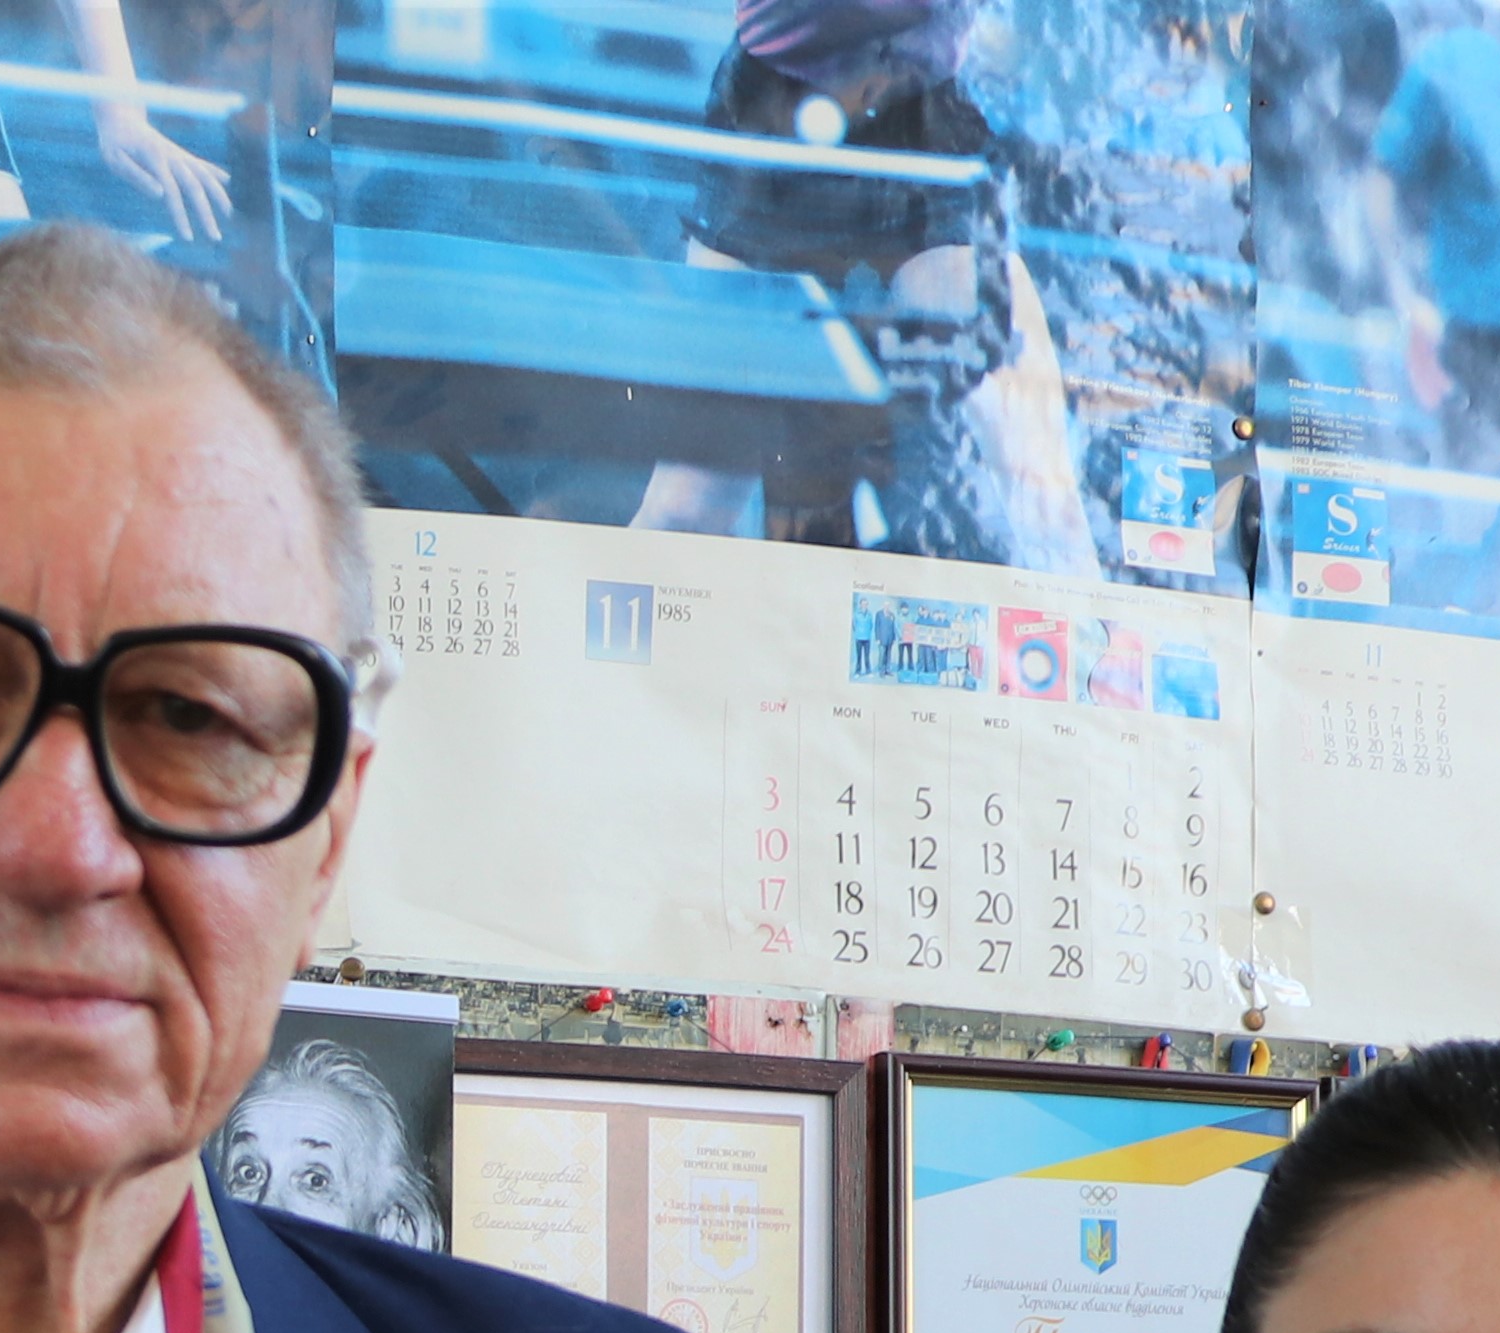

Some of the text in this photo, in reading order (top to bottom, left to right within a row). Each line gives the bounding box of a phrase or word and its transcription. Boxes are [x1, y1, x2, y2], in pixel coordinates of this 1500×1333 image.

[1327, 494, 1358, 536] S
[599, 586, 713, 652] 11 NOVEMBER
[656, 603, 692, 623] 1985
[833, 707, 861, 721] MON
[911, 711, 938, 724] TUE
[983, 717, 1010, 730] WED
[1053, 724, 1077, 738] THU
[763, 776, 1205, 848] 3 4 5 6 7 9
[755, 828, 1208, 897] 10 11 12 13 14 16
[757, 878, 1082, 931] 17 18 19 20 21
[759, 923, 1214, 993] 24 25 26 27 28 30
